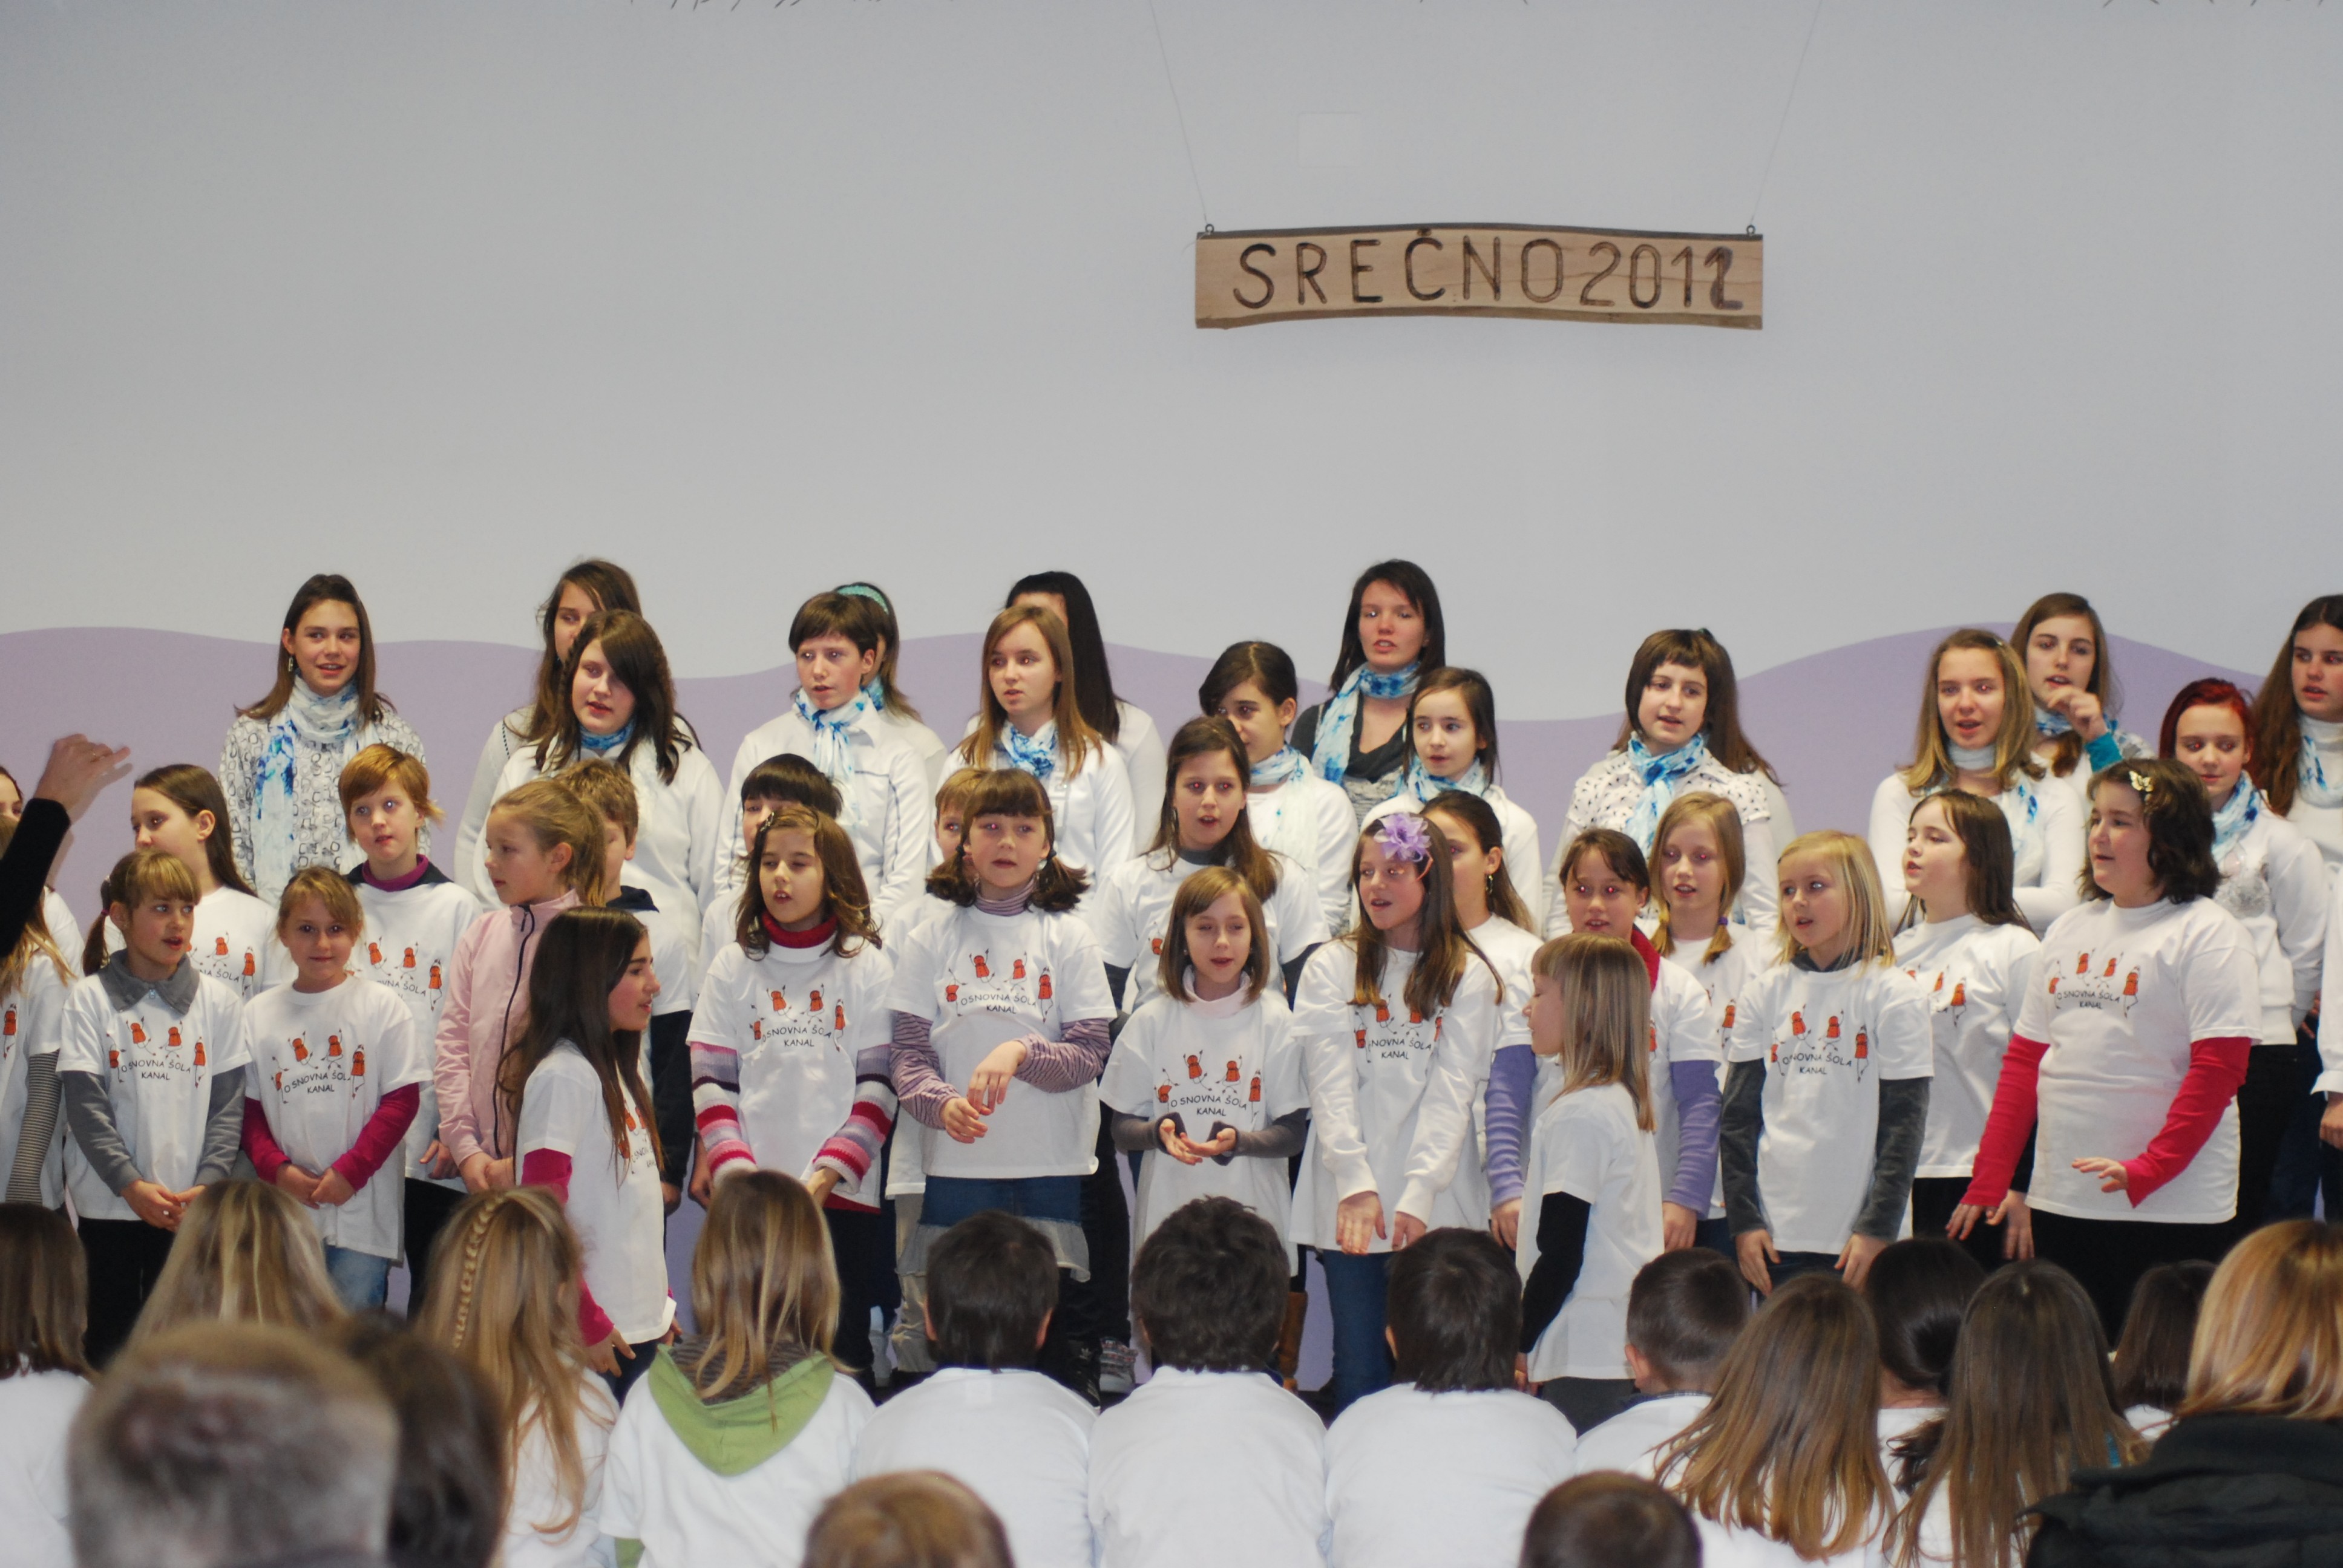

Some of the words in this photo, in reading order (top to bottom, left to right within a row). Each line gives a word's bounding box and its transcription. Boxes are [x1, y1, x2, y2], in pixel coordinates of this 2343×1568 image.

[1233, 227, 1564, 309] SREČNO
[1579, 241, 1744, 310] 2012
[402, 981, 427, 997] ŠOLA
[960, 993, 1011, 1005] OSNOVNA
[986, 1005, 1017, 1014] KANAL
[811, 1024, 832, 1039] ŠOA
[1408, 1037, 1432, 1050] ŠOLA
[1381, 1050, 1409, 1060] KANAL
[1826, 1052, 1852, 1067] ŠOLA
[168, 1059, 191, 1074] ŠOLA
[1800, 1066, 1827, 1075] KANAL
[141, 1071, 171, 1081] KANAL
[307, 1084, 335, 1094] KANAL
[1196, 1107, 1227, 1117] KANAL
